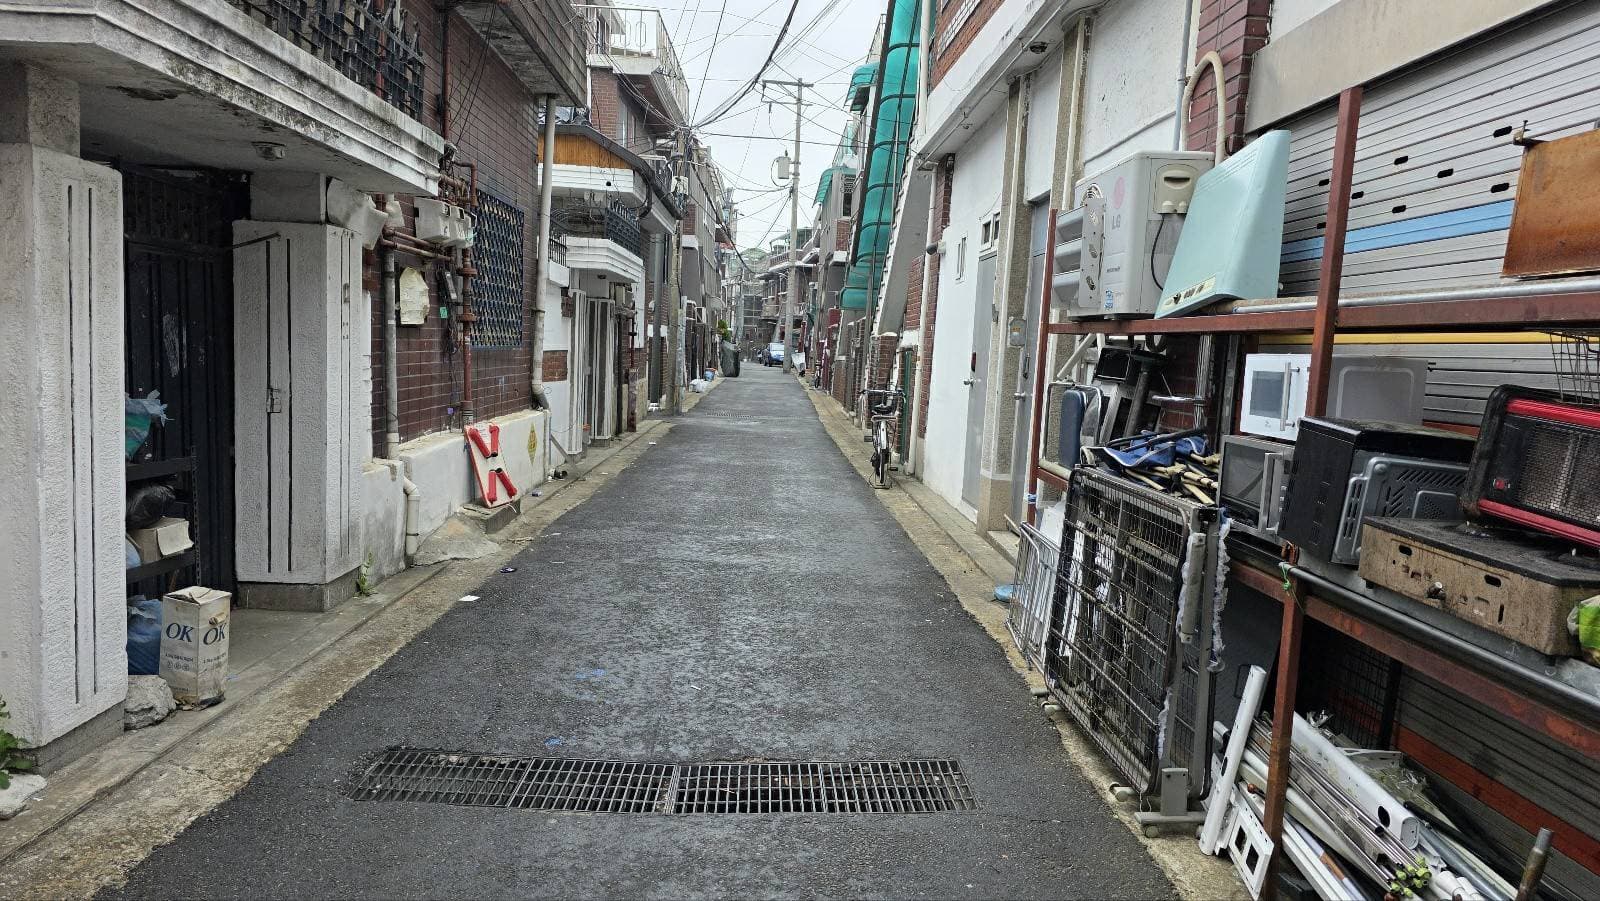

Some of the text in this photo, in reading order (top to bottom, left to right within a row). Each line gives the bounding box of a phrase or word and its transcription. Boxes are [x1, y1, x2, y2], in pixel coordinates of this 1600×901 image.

[1112, 214, 1121, 230] LG
[166, 622, 194, 643] OK
[203, 622, 227, 645] OK
